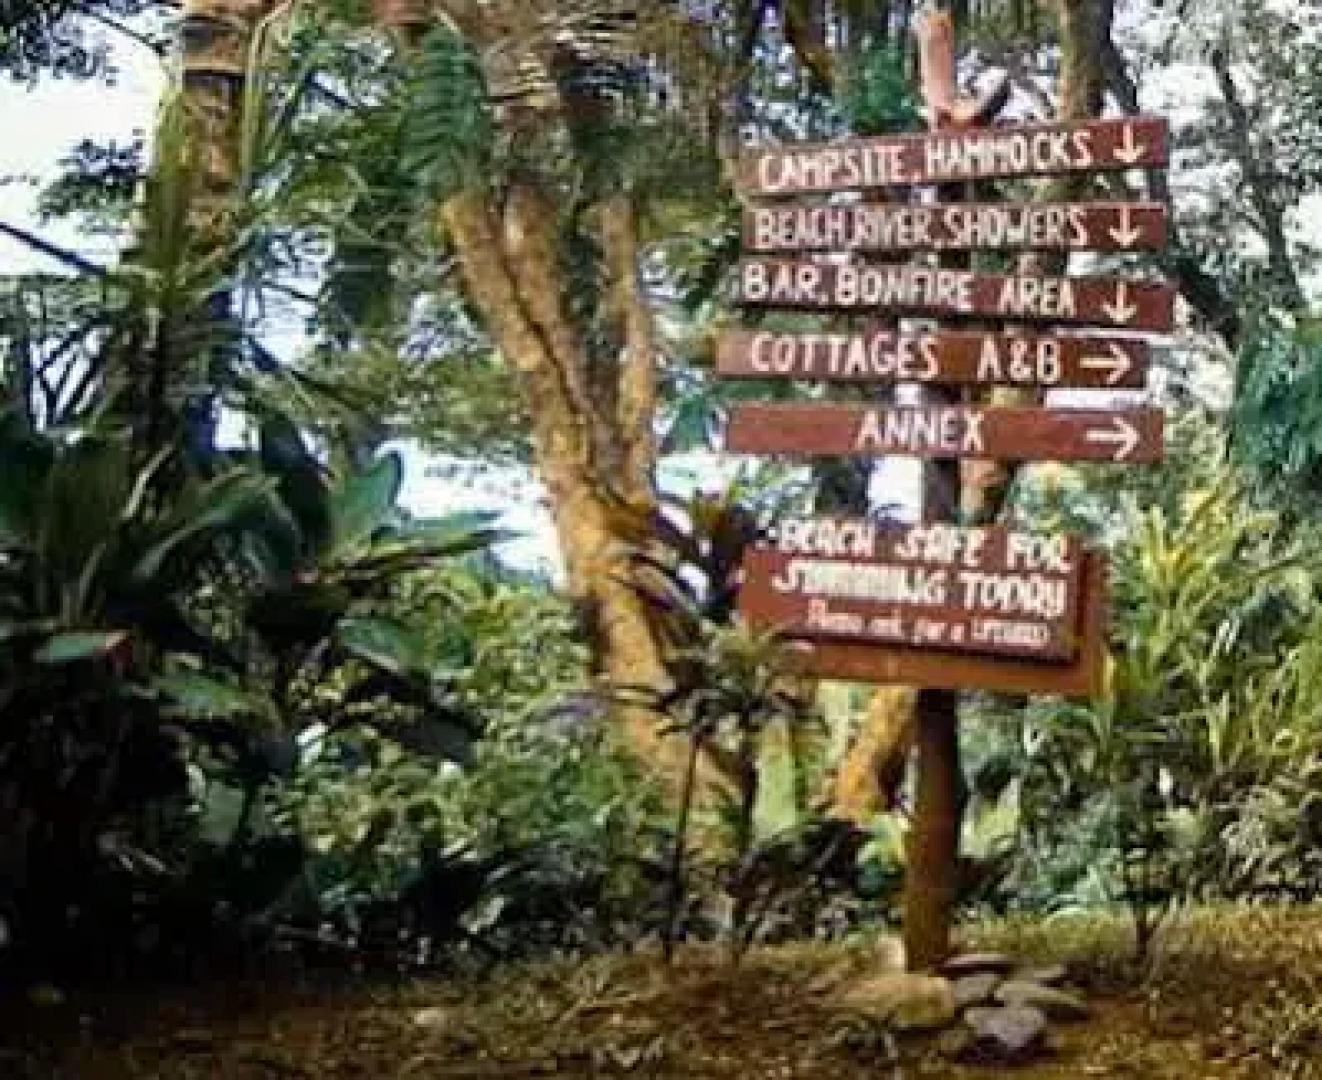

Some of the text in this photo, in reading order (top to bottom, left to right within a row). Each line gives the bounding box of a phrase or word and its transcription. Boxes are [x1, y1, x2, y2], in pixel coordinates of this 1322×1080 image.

[926, 130, 1092, 171] HAMMOCKS
[943, 206, 1090, 249] SHOWERS
[835, 267, 976, 311] BONFIRE
[1000, 279, 1077, 316] AREA
[750, 331, 1061, 381] COTTAGES A&B
[855, 410, 985, 451] ANNEX
[779, 518, 1072, 573] BEACH SAFE FOR
[958, 571, 1068, 618] TODAY
